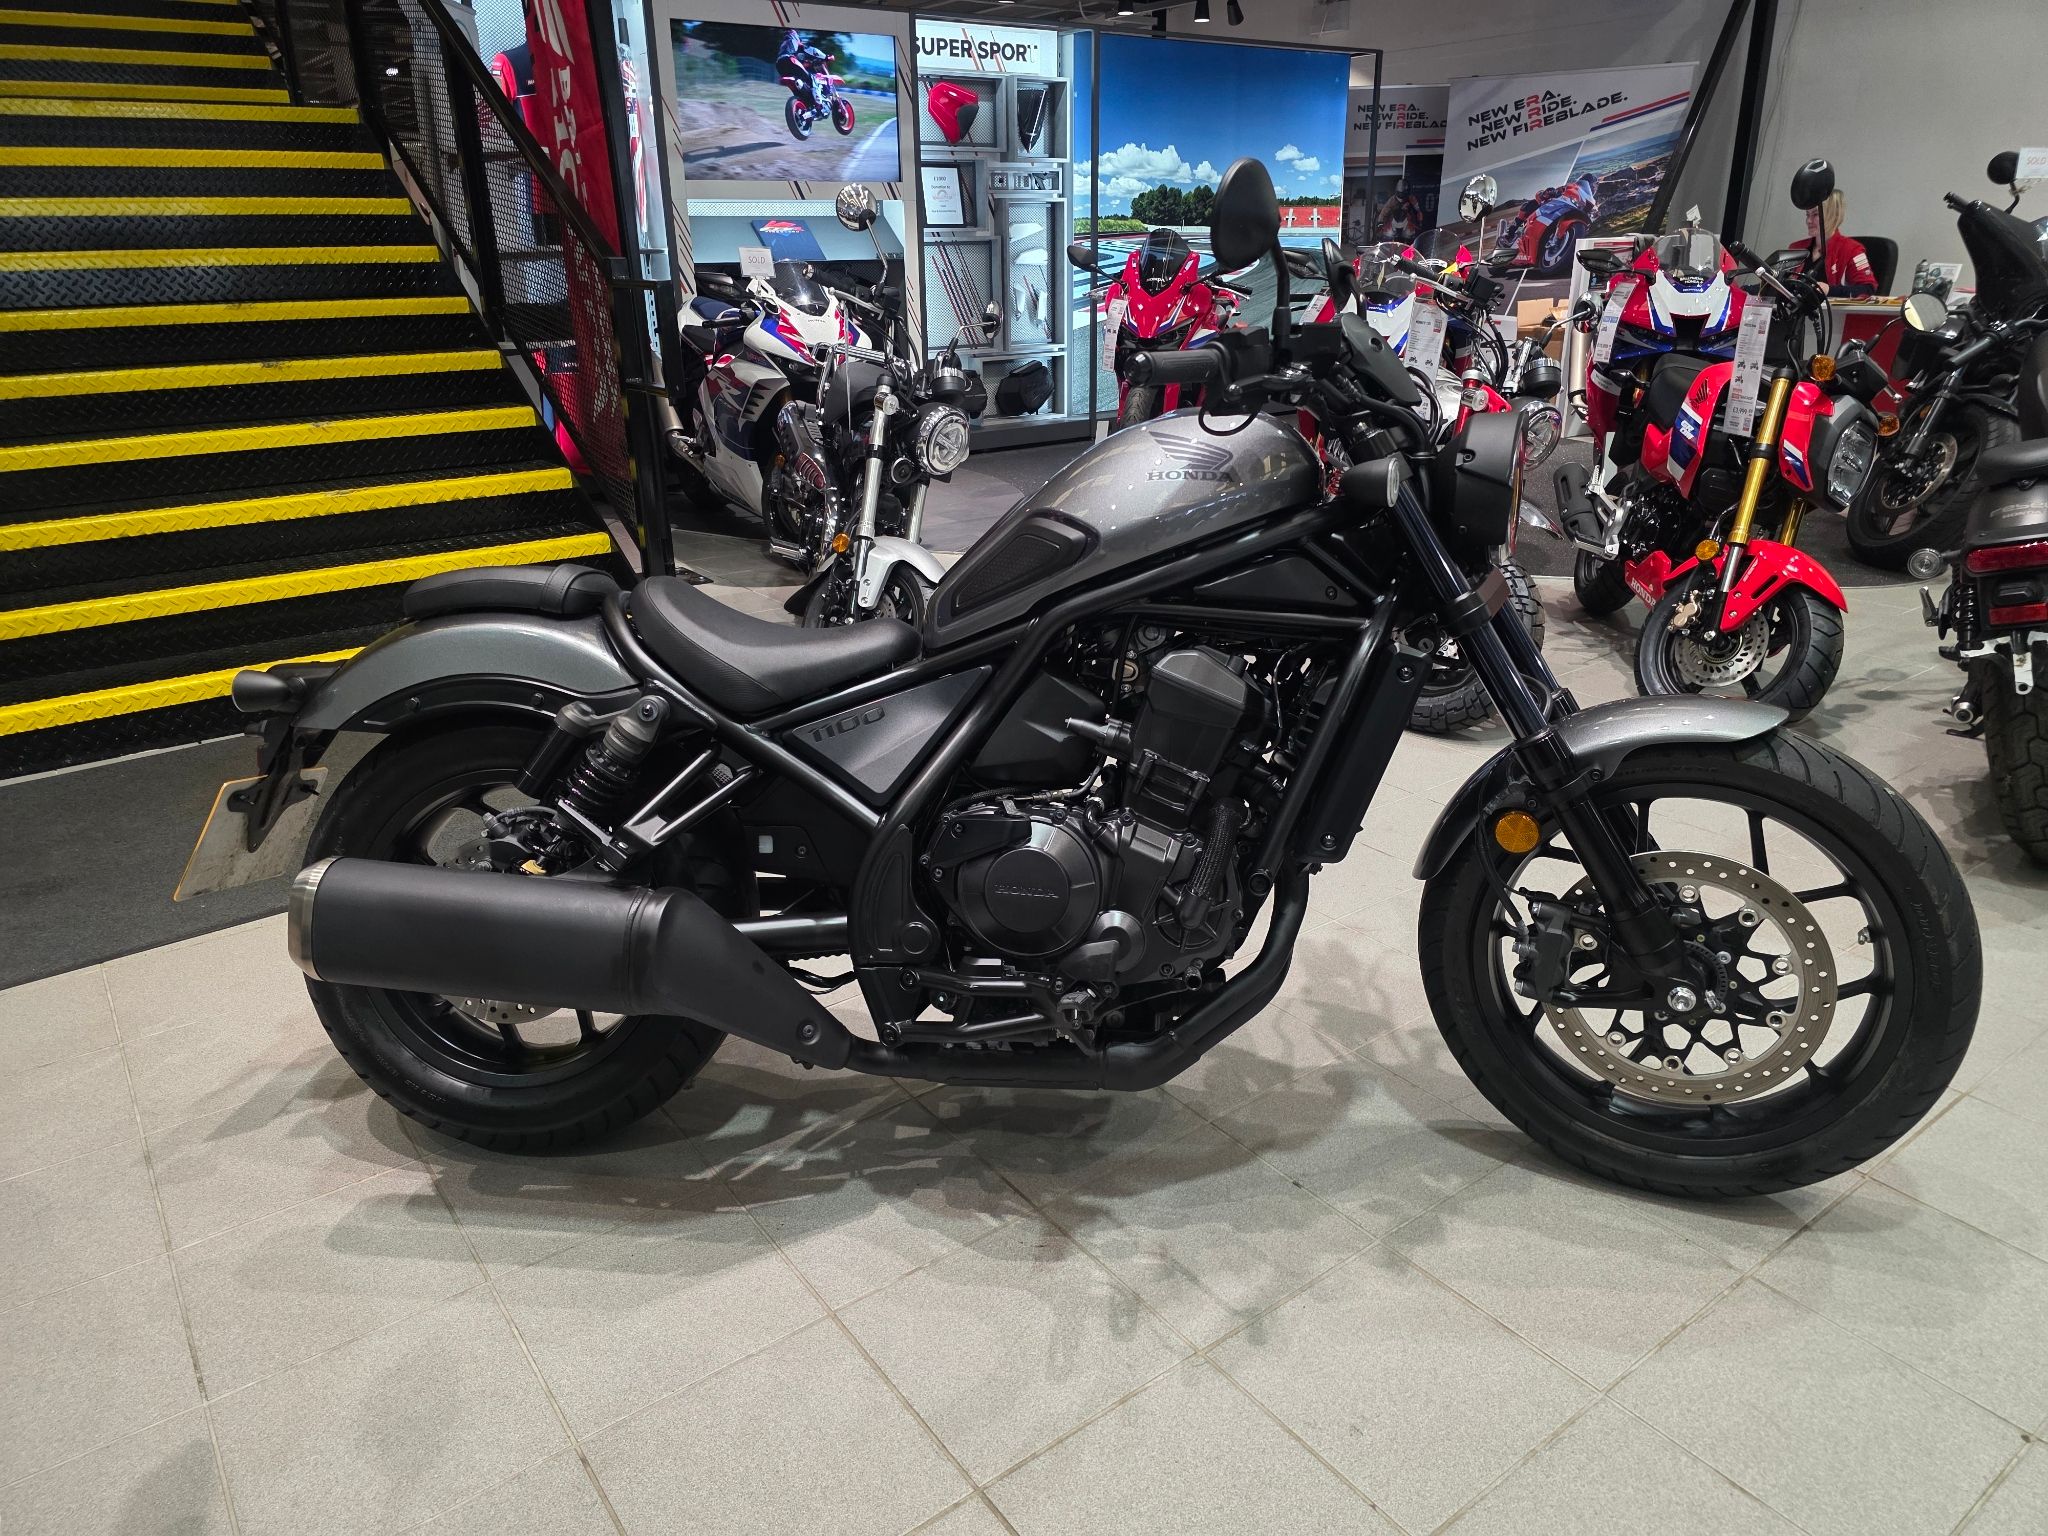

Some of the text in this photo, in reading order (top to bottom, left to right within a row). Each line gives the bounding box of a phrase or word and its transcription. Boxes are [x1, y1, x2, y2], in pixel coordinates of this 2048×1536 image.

[1389, 103, 1420, 112] ERA.
[1396, 112, 1429, 121] RIDE.
[1468, 89, 1562, 126] NEW ERA.
[1481, 95, 1578, 134] NEW RIDE.
[1467, 91, 1629, 151] NEW FIREBLADE.
[748, 255, 766, 265] SOLD
[1146, 470, 1235, 483] HONDA
[1631, 577, 1657, 606] HONDA
[808, 707, 886, 743] 1100
[994, 882, 1060, 899] HONDA
